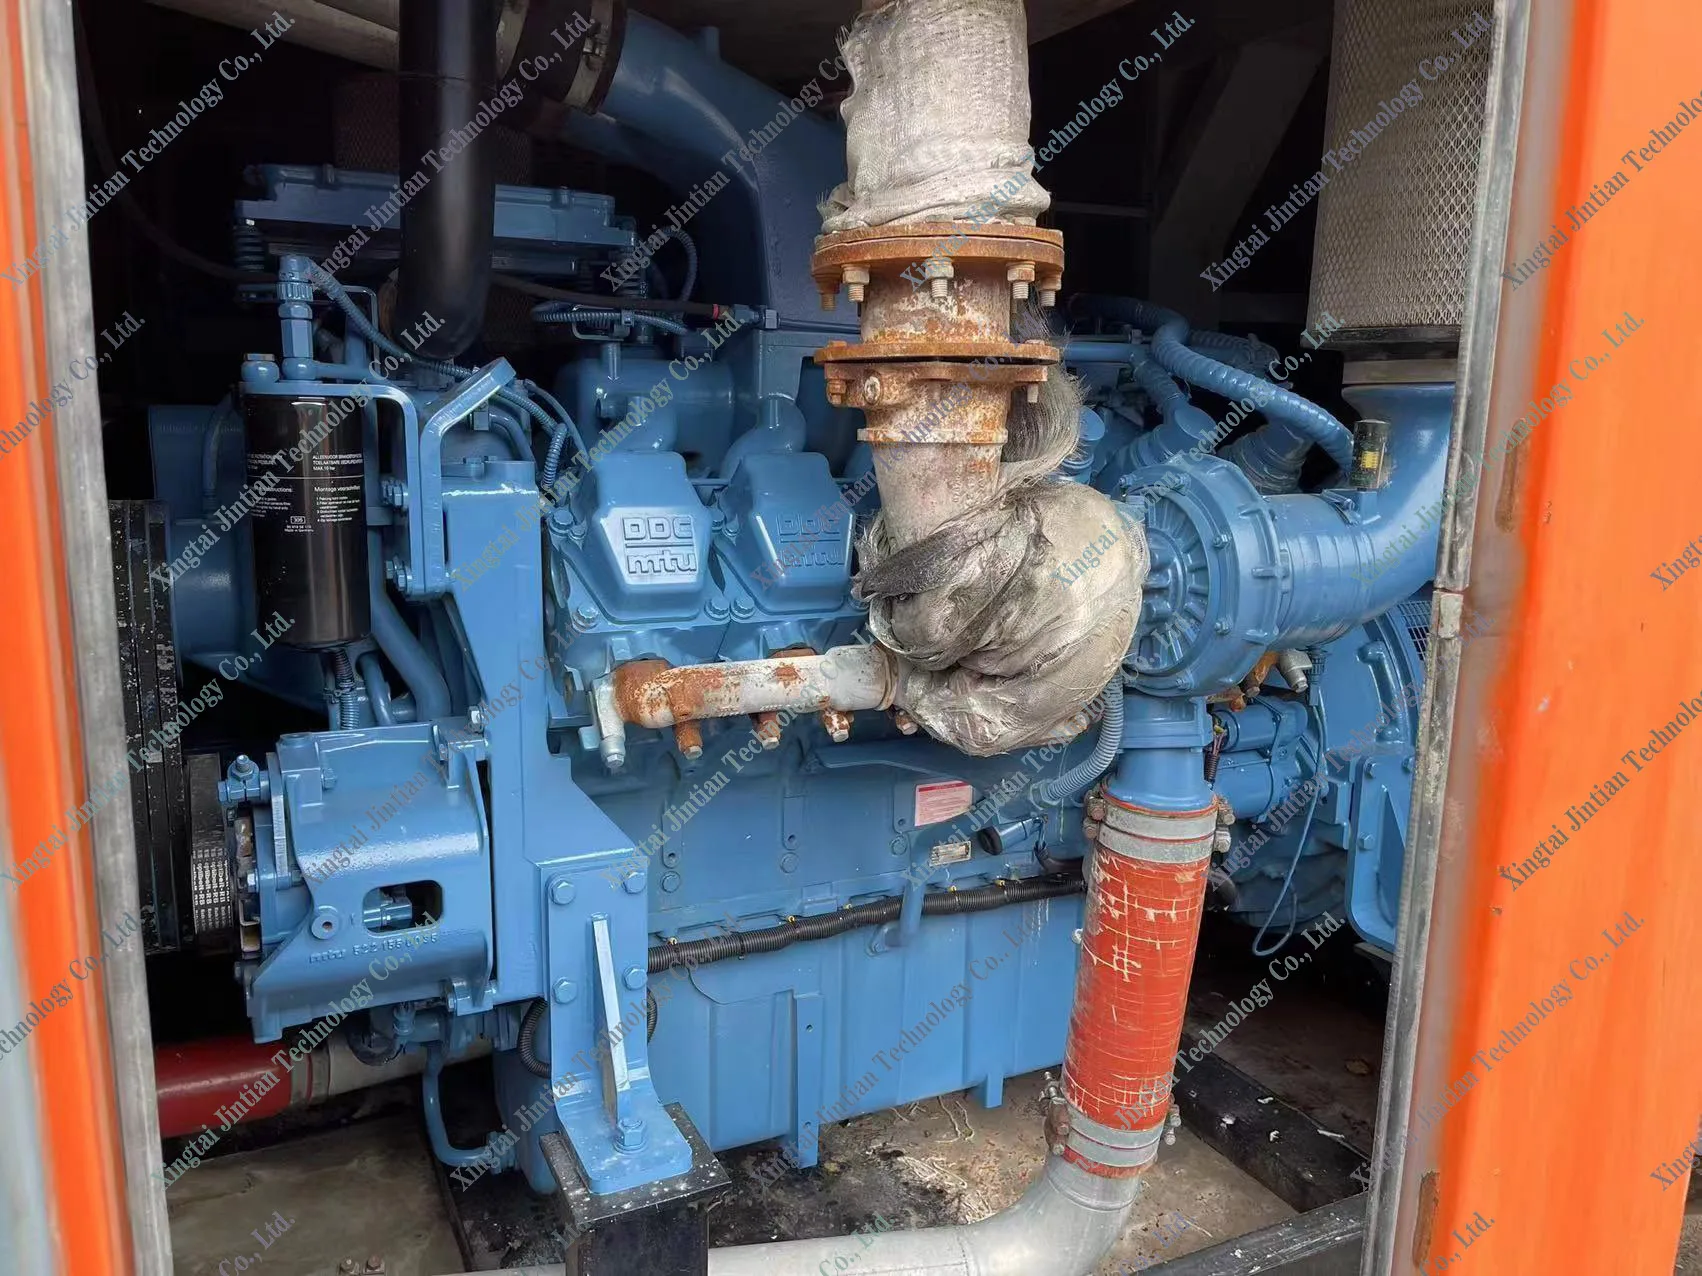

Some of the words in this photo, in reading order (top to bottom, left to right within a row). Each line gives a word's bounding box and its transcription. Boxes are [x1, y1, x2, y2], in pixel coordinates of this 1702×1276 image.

[622, 516, 694, 541] DDC
[776, 511, 841, 537] DDC
[627, 549, 698, 575] mtu
